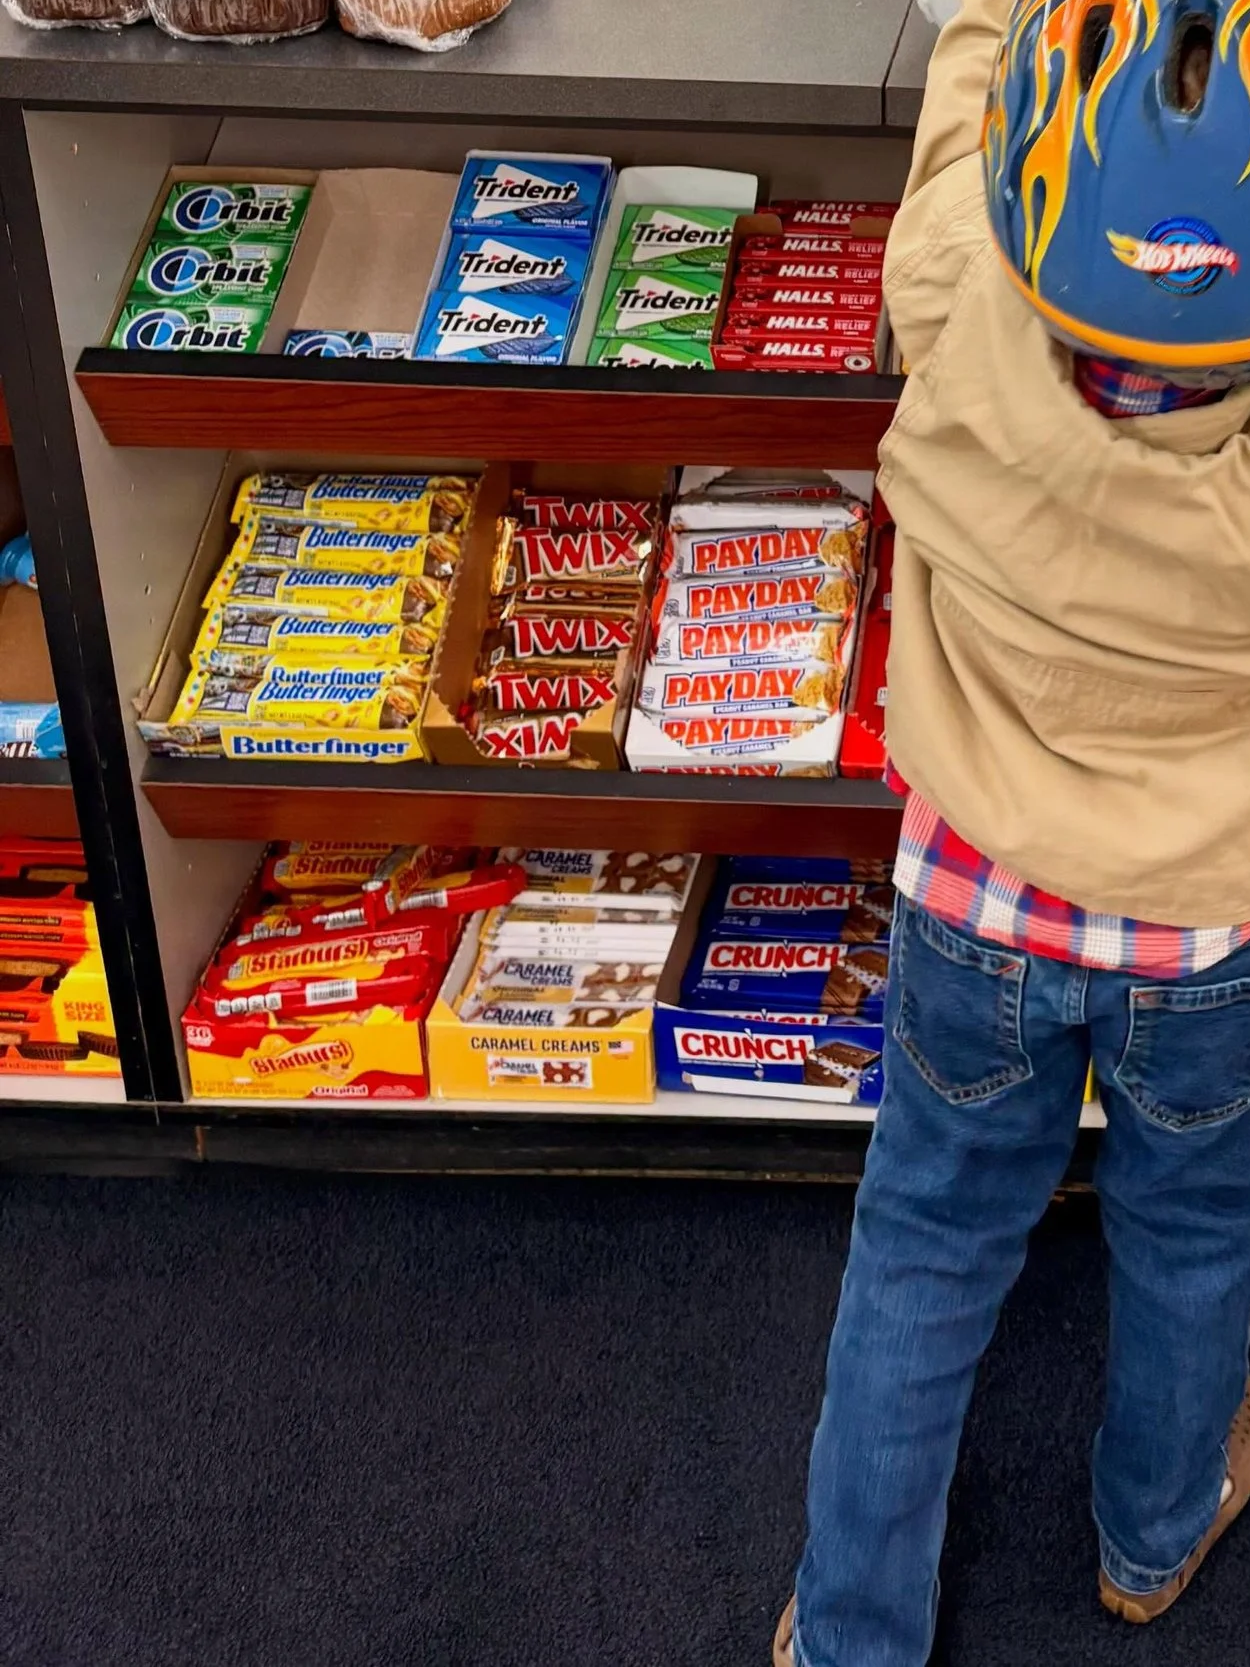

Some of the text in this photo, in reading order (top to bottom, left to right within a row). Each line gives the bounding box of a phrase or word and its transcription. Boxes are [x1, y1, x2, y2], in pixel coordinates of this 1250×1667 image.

[173, 185, 297, 233] Orbit
[148, 245, 271, 296] Orbit
[461, 252, 565, 276] Trident
[773, 290, 834, 305] HALLS
[440, 310, 546, 335] Trident
[766, 315, 828, 330] HALLS
[687, 574, 825, 619] PAYDAY
[277, 617, 394, 639] Butterfinger
[508, 618, 634, 657] TWIX
[490, 671, 616, 713] TWIX
[663, 668, 804, 710] PAYDAY
[233, 736, 411, 759] Butterfinger
[710, 944, 839, 970] CRUNCH
[503, 961, 574, 981] CARAMEL
[64, 1001, 105, 1011] KING
[65, 1011, 107, 1023] SIZE
[471, 1036, 600, 1054] CARAMEL CREAMS
[680, 1033, 808, 1062] CRUNCH
